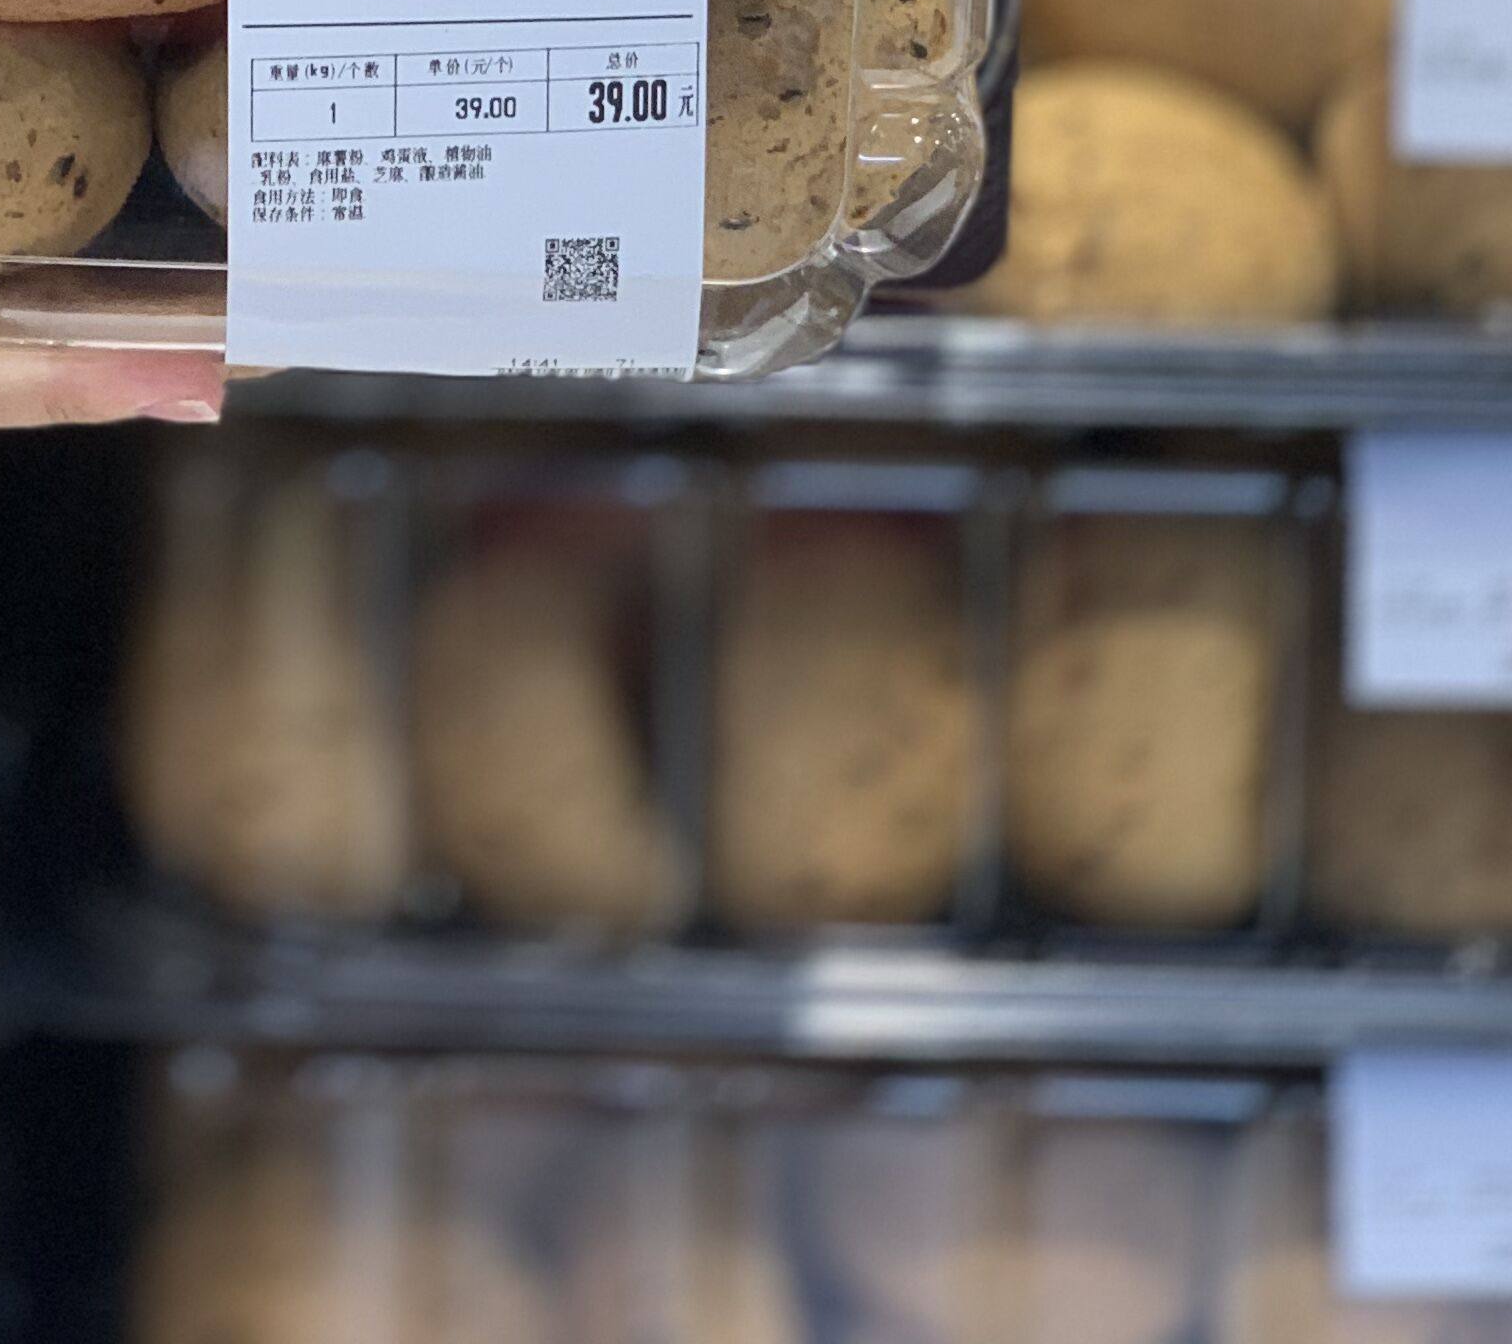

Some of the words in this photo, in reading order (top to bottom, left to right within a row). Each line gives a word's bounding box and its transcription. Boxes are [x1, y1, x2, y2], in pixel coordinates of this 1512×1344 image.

[606, 53, 639, 71] 总价
[455, 96, 517, 120] 39.00
[588, 78, 667, 124] 39.00
[678, 85, 695, 118] 元
[330, 102, 337, 124] 1
